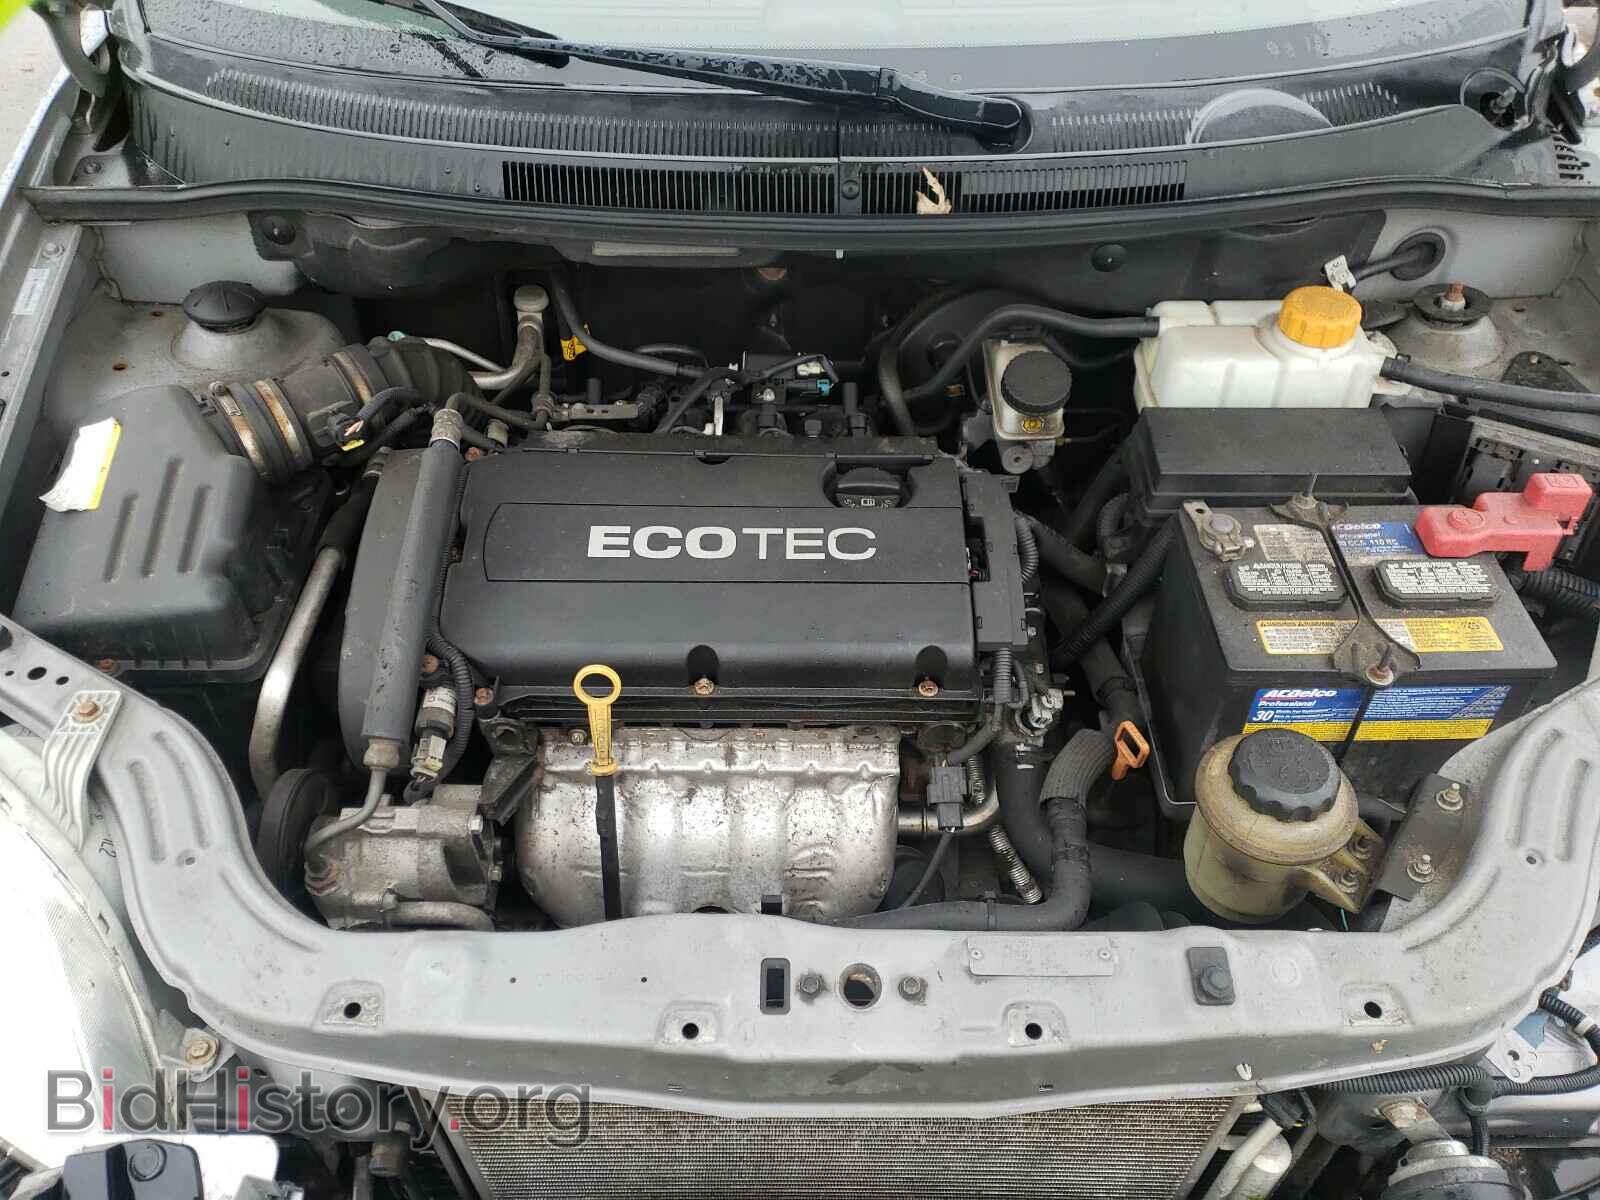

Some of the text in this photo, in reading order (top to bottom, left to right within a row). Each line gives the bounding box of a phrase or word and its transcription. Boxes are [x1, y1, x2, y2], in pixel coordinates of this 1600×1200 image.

[587, 525, 877, 561] ECOTEC
[1262, 688, 1338, 698] ACDelco
[1258, 700, 1317, 708] Professional
[1252, 710, 1275, 722] 30
